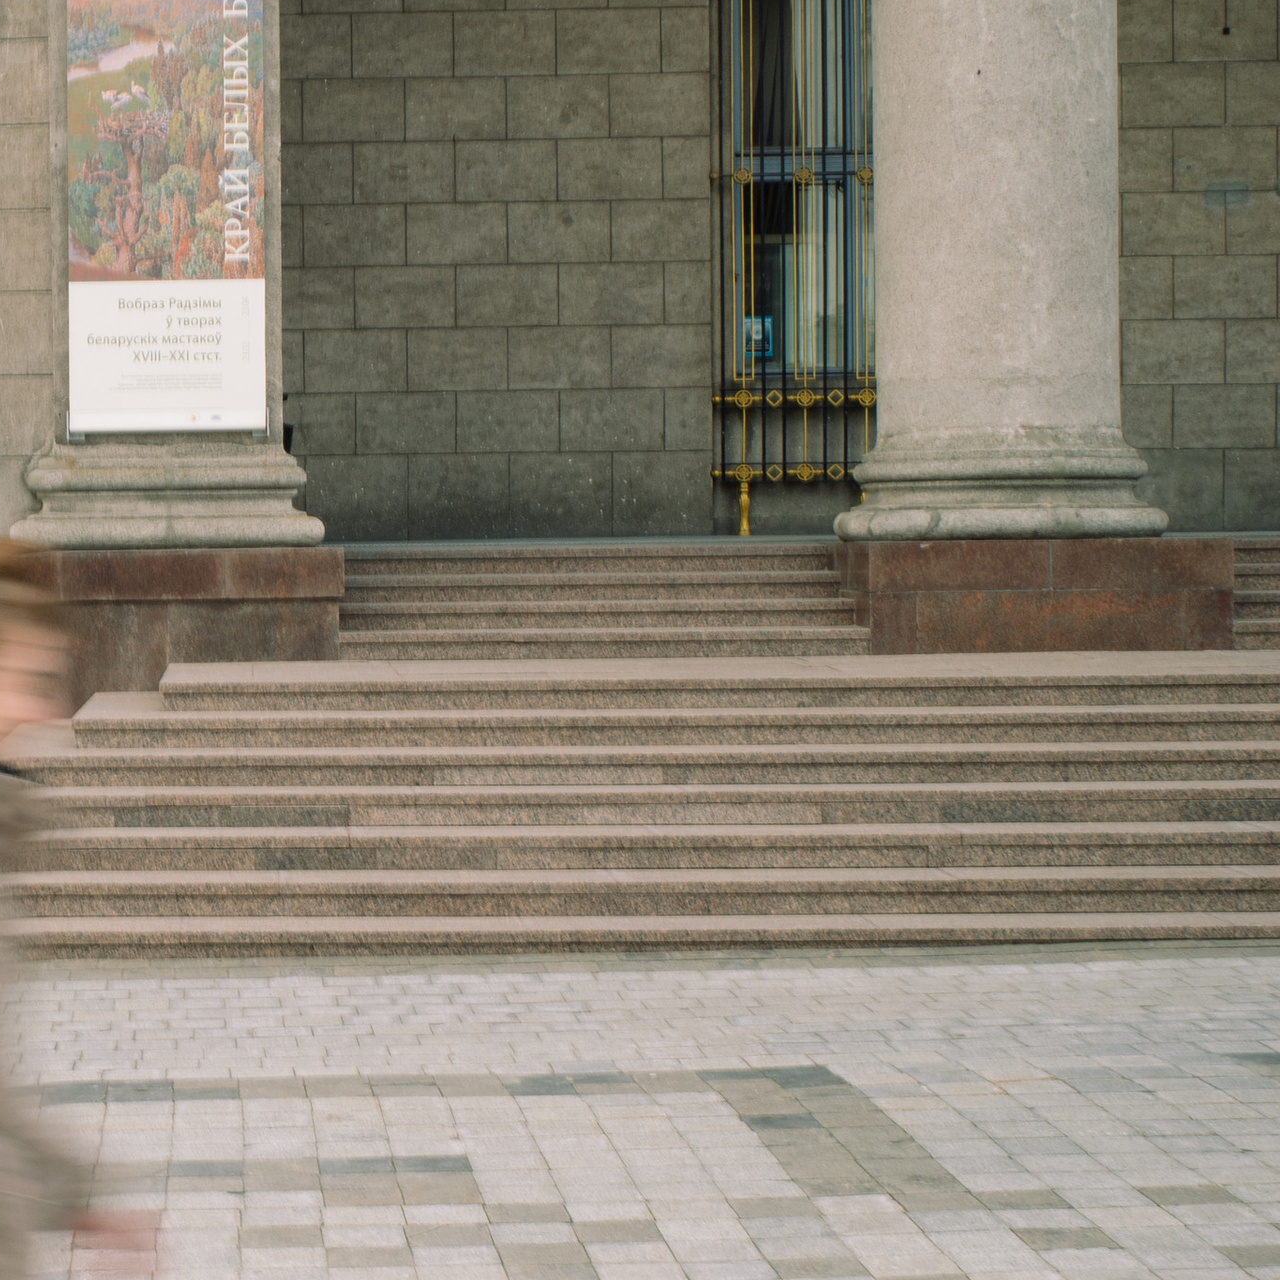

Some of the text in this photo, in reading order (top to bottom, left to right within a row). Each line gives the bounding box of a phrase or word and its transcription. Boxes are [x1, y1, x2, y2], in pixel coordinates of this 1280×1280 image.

[223, 33, 250, 152] БЕЛЫХ
[218, 167, 250, 263] КРАЙ
[118, 296, 222, 312] Вобраз Радзімы
[165, 315, 222, 329] ў творах
[87, 332, 223, 347] беларускіх мастакоў
[194, 351, 222, 362] стст.
